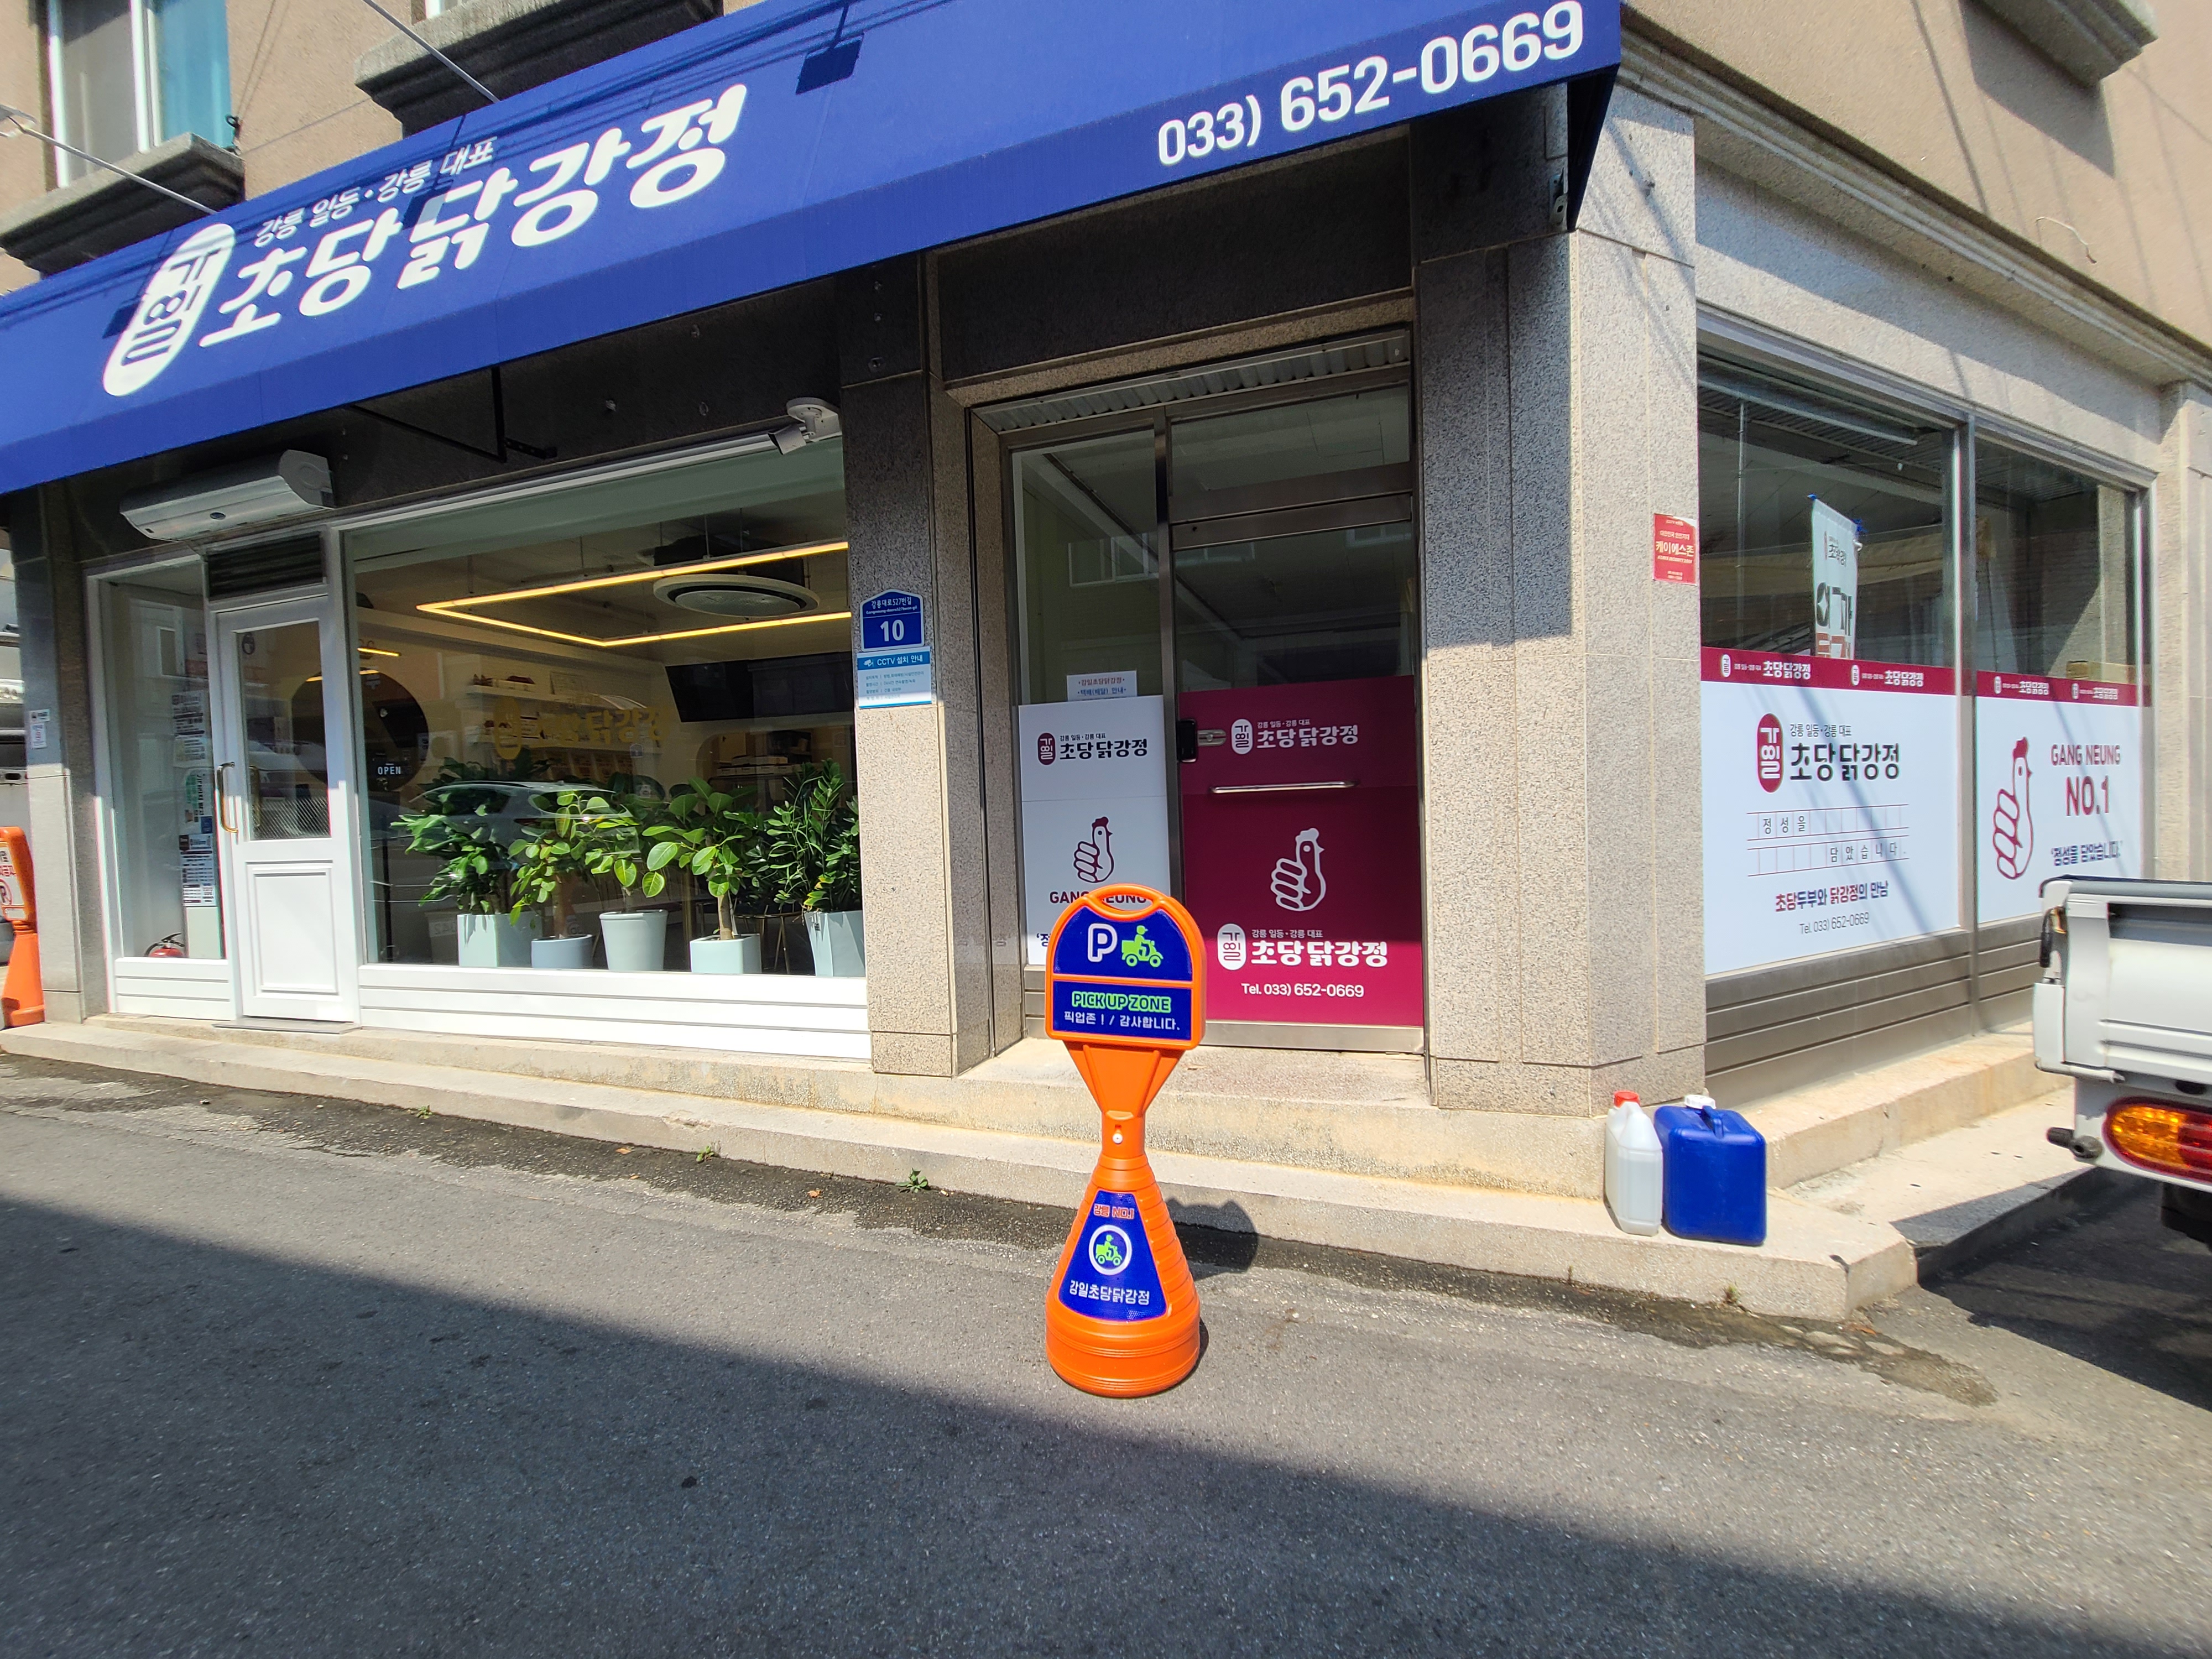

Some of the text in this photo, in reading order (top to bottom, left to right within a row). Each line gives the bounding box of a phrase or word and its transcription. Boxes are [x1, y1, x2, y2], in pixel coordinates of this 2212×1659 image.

[1158, 0, 1584, 165] 033) 652-0669
[254, 207, 305, 247] 강릉
[440, 136, 497, 175] 대표
[1656, 541, 1694, 557] 케이에스존
[872, 597, 911, 609] 강릉대로527번길
[880, 619, 904, 641] 10
[877, 658, 895, 666] CCTV
[911, 655, 923, 663] 안내
[1790, 723, 1803, 737] 강릉
[1839, 724, 1852, 737] 대표
[2051, 744, 2121, 766] GANG NEUNG
[378, 766, 401, 775] OPEN
[2065, 775, 2109, 816] NO.1
[1775, 880, 1888, 912] 초당두부와 닭강정의 만남
[1814, 919, 1829, 933] 033)
[1831, 911, 1869, 930] 652-0669
[1088, 923, 1118, 962] P
[1251, 930, 1266, 938] 강릉
[1307, 930, 1323, 938] 대표
[1241, 983, 1364, 998] Tel. 033) 652-0669
[1072, 991, 1171, 1013] PICK UP ZONE
[1064, 1011, 1096, 1025] 픽업존
[1120, 1015, 1180, 1030] 감사합니다.
[1093, 1203, 1134, 1220] 강릉 NO.1
